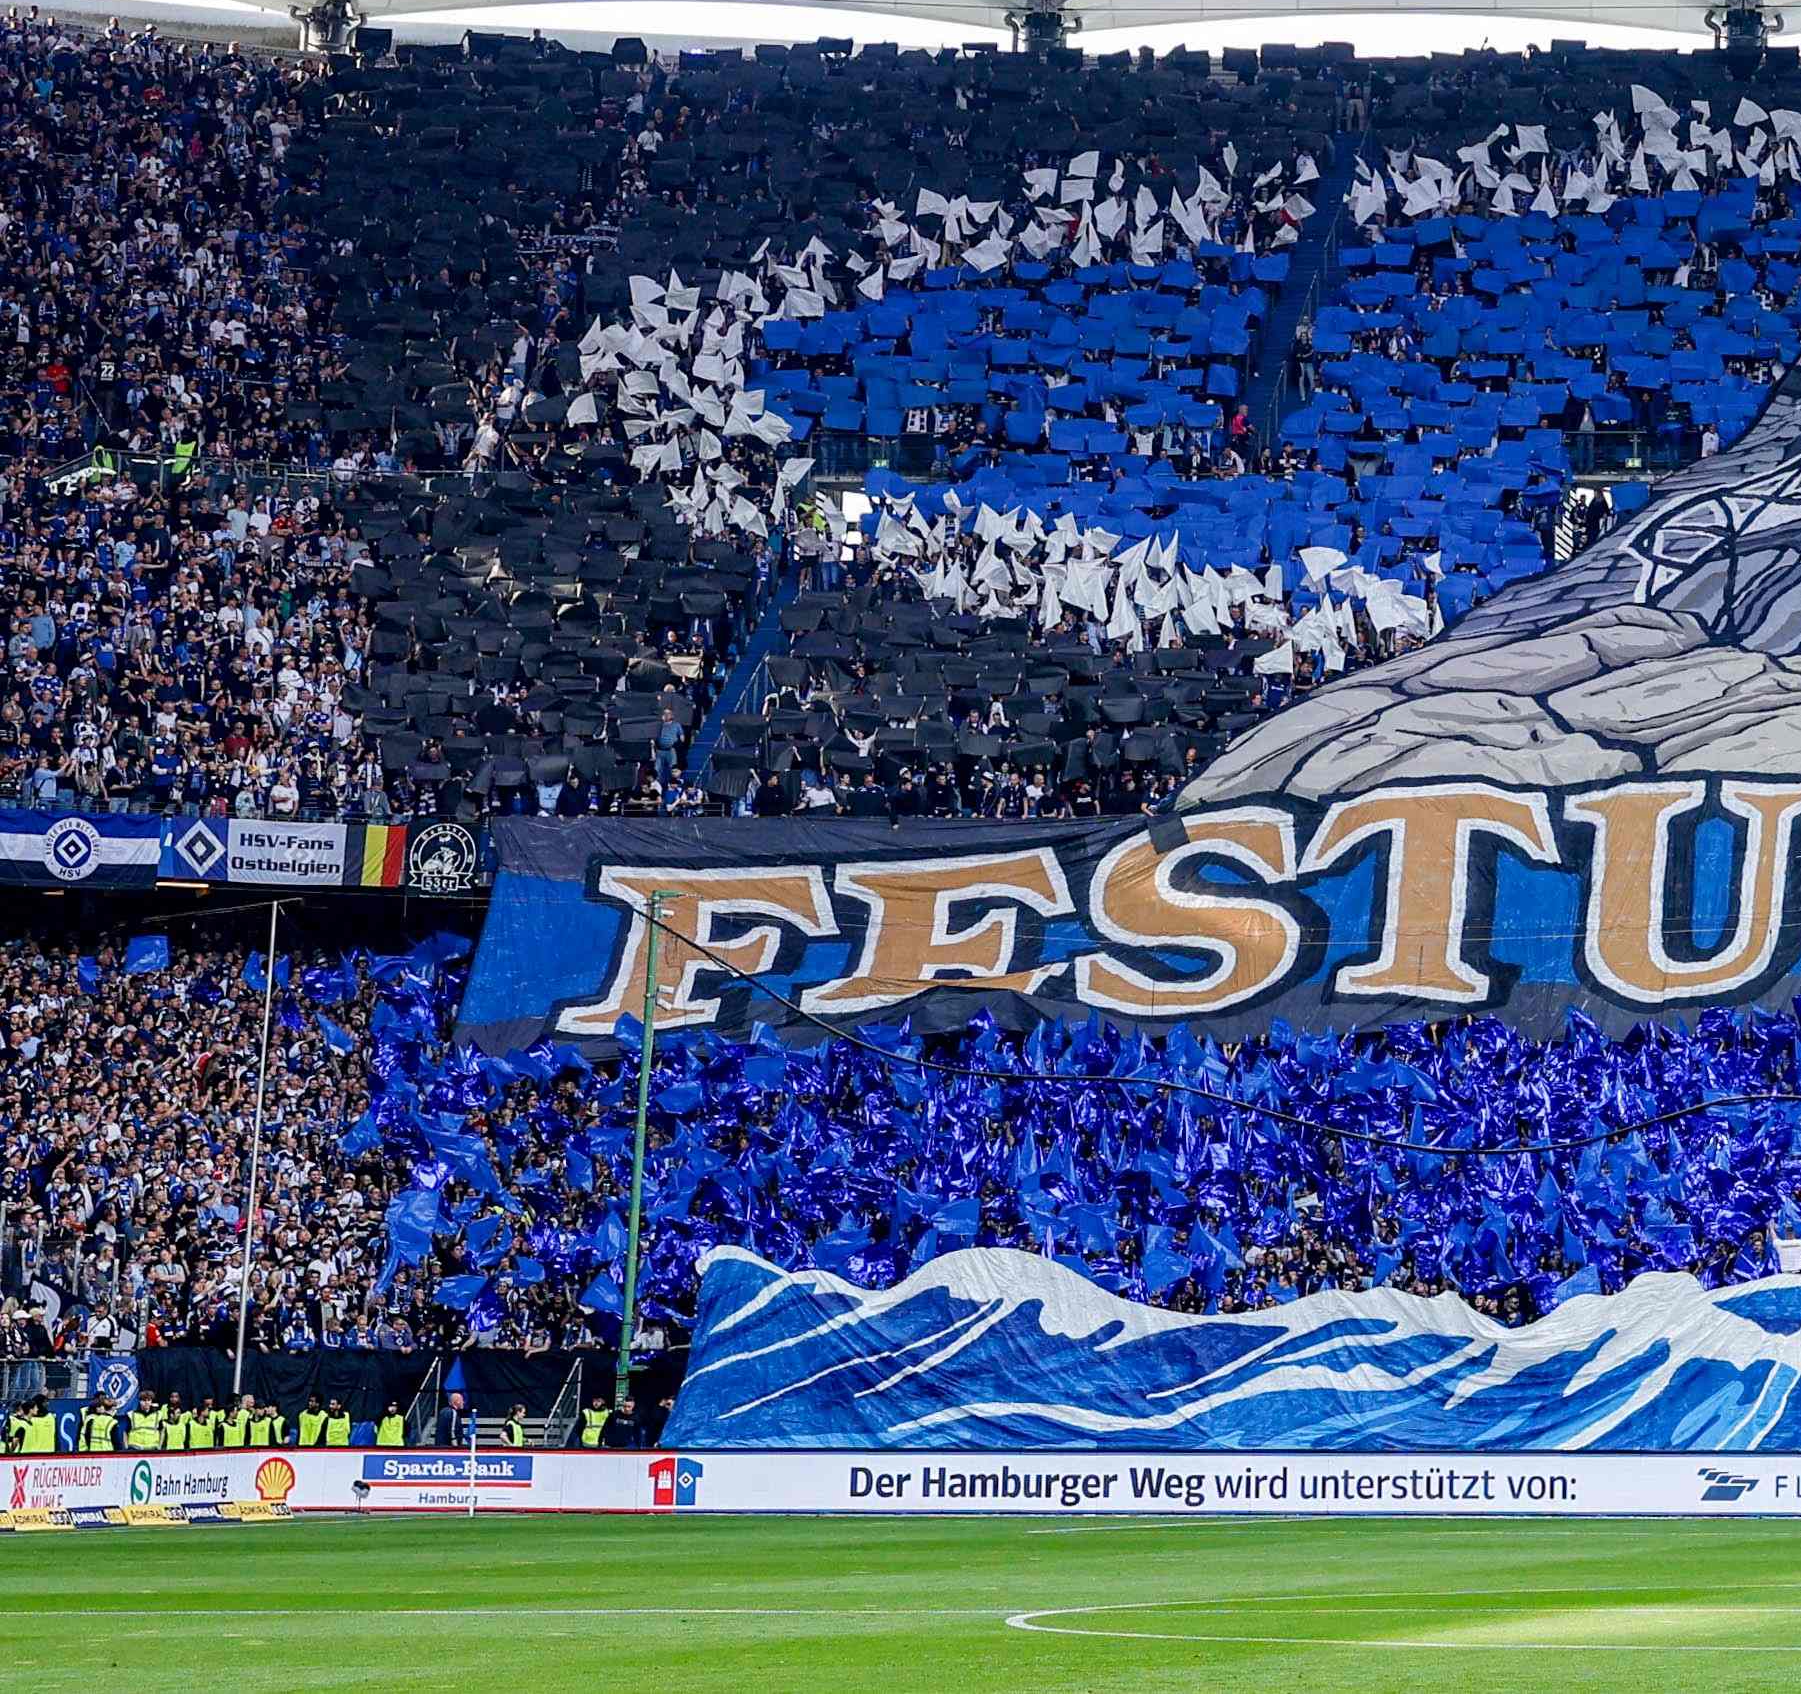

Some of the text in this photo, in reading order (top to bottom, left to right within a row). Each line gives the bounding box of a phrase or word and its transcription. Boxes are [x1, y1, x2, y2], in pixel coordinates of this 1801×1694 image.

[101, 365, 114, 378] 22
[240, 833, 334, 851] HSV-Fans
[59, 868, 81, 878] HSV
[231, 856, 340, 876] Ostbelgien
[32, 1462, 103, 1489] RÜGENWALDER
[155, 1474, 181, 1497] Bahn
[183, 1472, 229, 1498] Hamburg
[849, 1466, 1577, 1506] Der Hamburger Weg wird unterstützt von:
